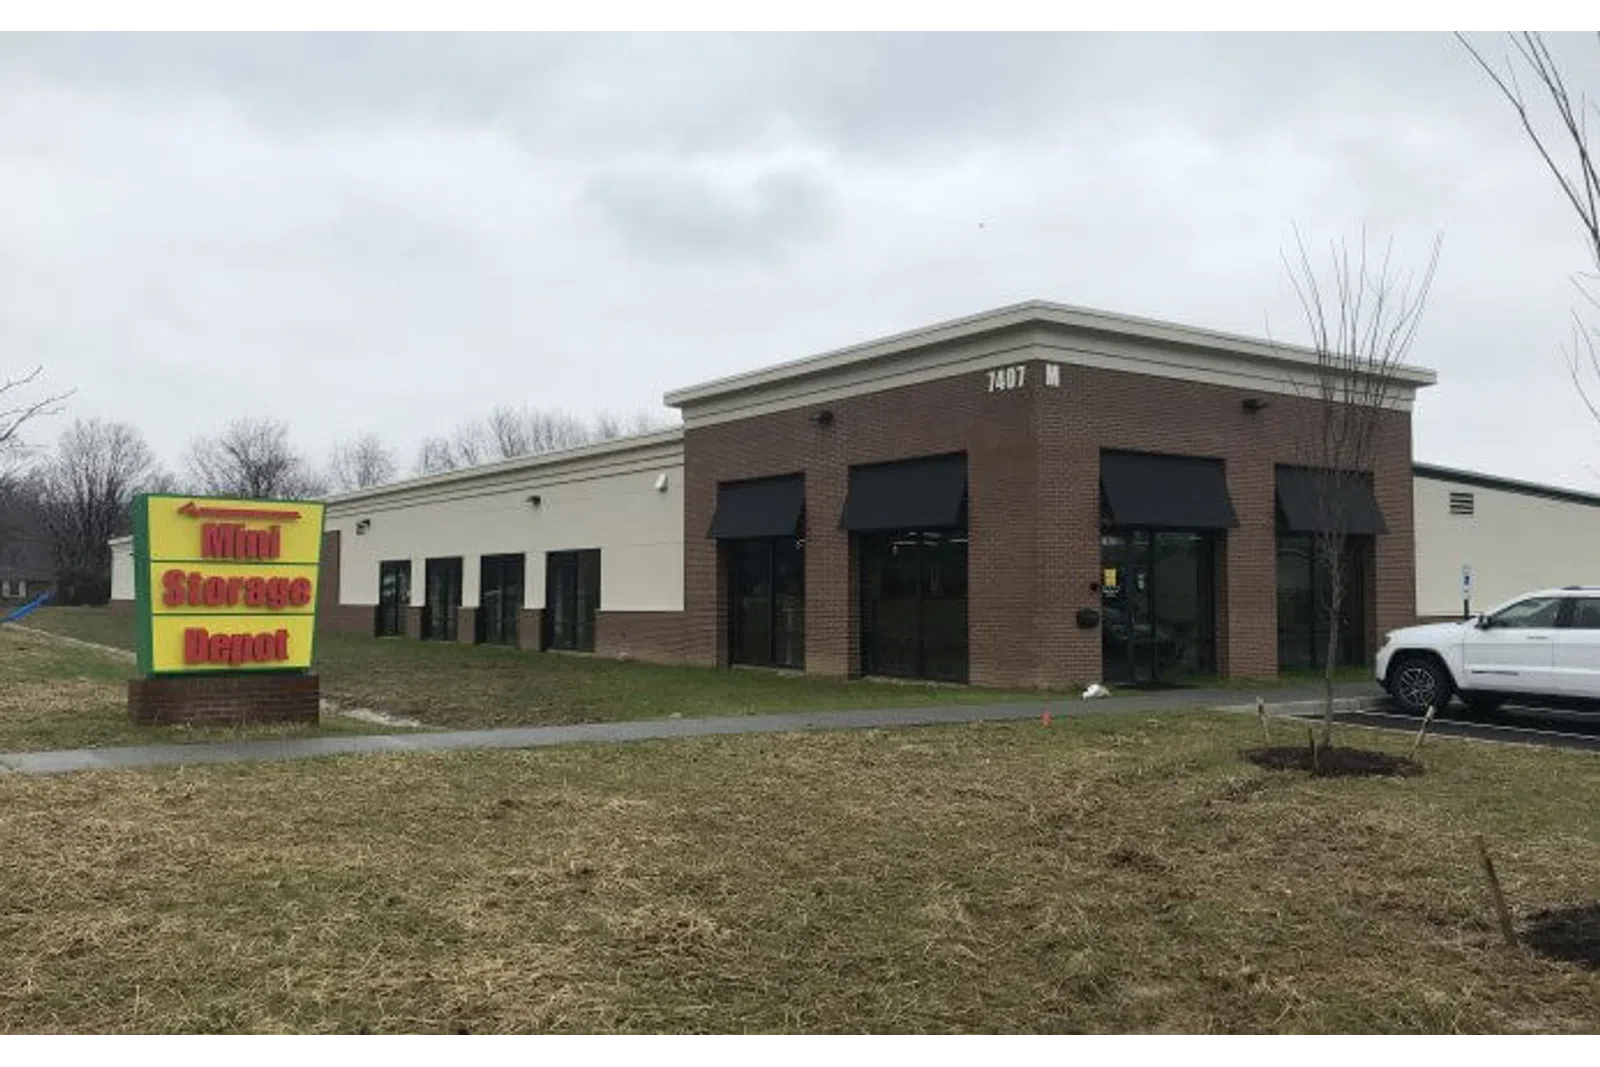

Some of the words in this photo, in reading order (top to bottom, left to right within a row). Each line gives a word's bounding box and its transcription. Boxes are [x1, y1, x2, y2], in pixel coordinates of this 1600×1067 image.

[986, 365, 1026, 392] 7407
[202, 522, 280, 559] Mini
[161, 568, 312, 609] Storage
[183, 627, 290, 665] Depot
